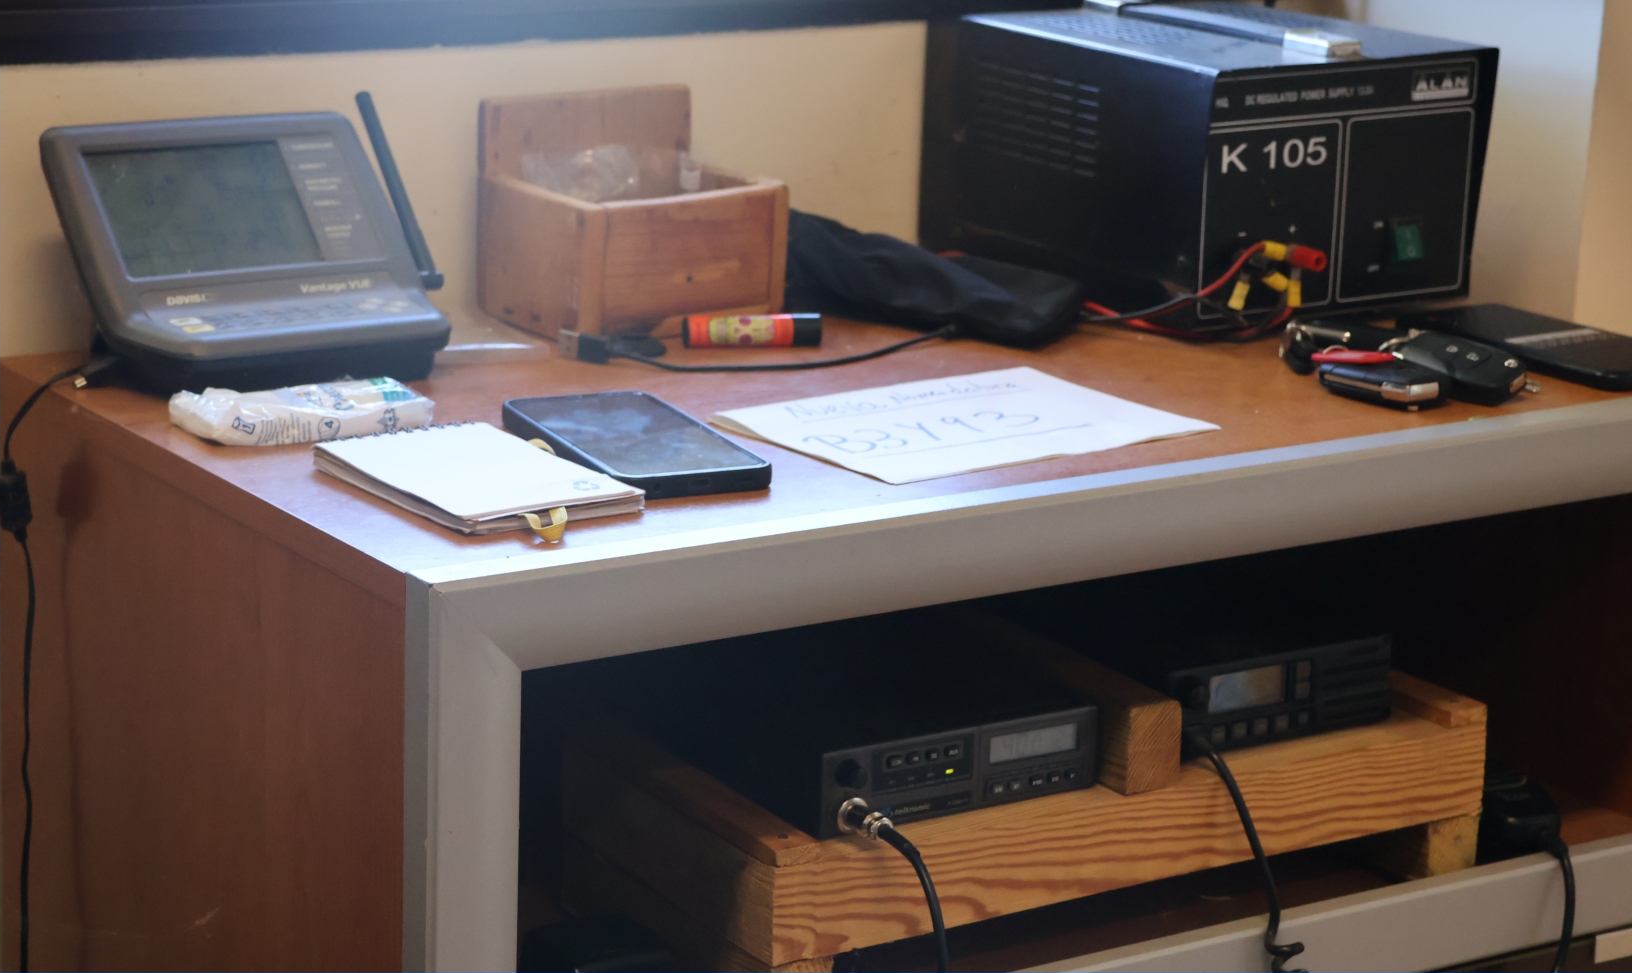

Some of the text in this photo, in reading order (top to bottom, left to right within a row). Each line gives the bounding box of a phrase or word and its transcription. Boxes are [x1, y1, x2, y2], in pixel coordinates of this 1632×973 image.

[1416, 74, 1468, 91] ALAN
[1221, 136, 1328, 175] K 105
[300, 280, 347, 294] Vantage
